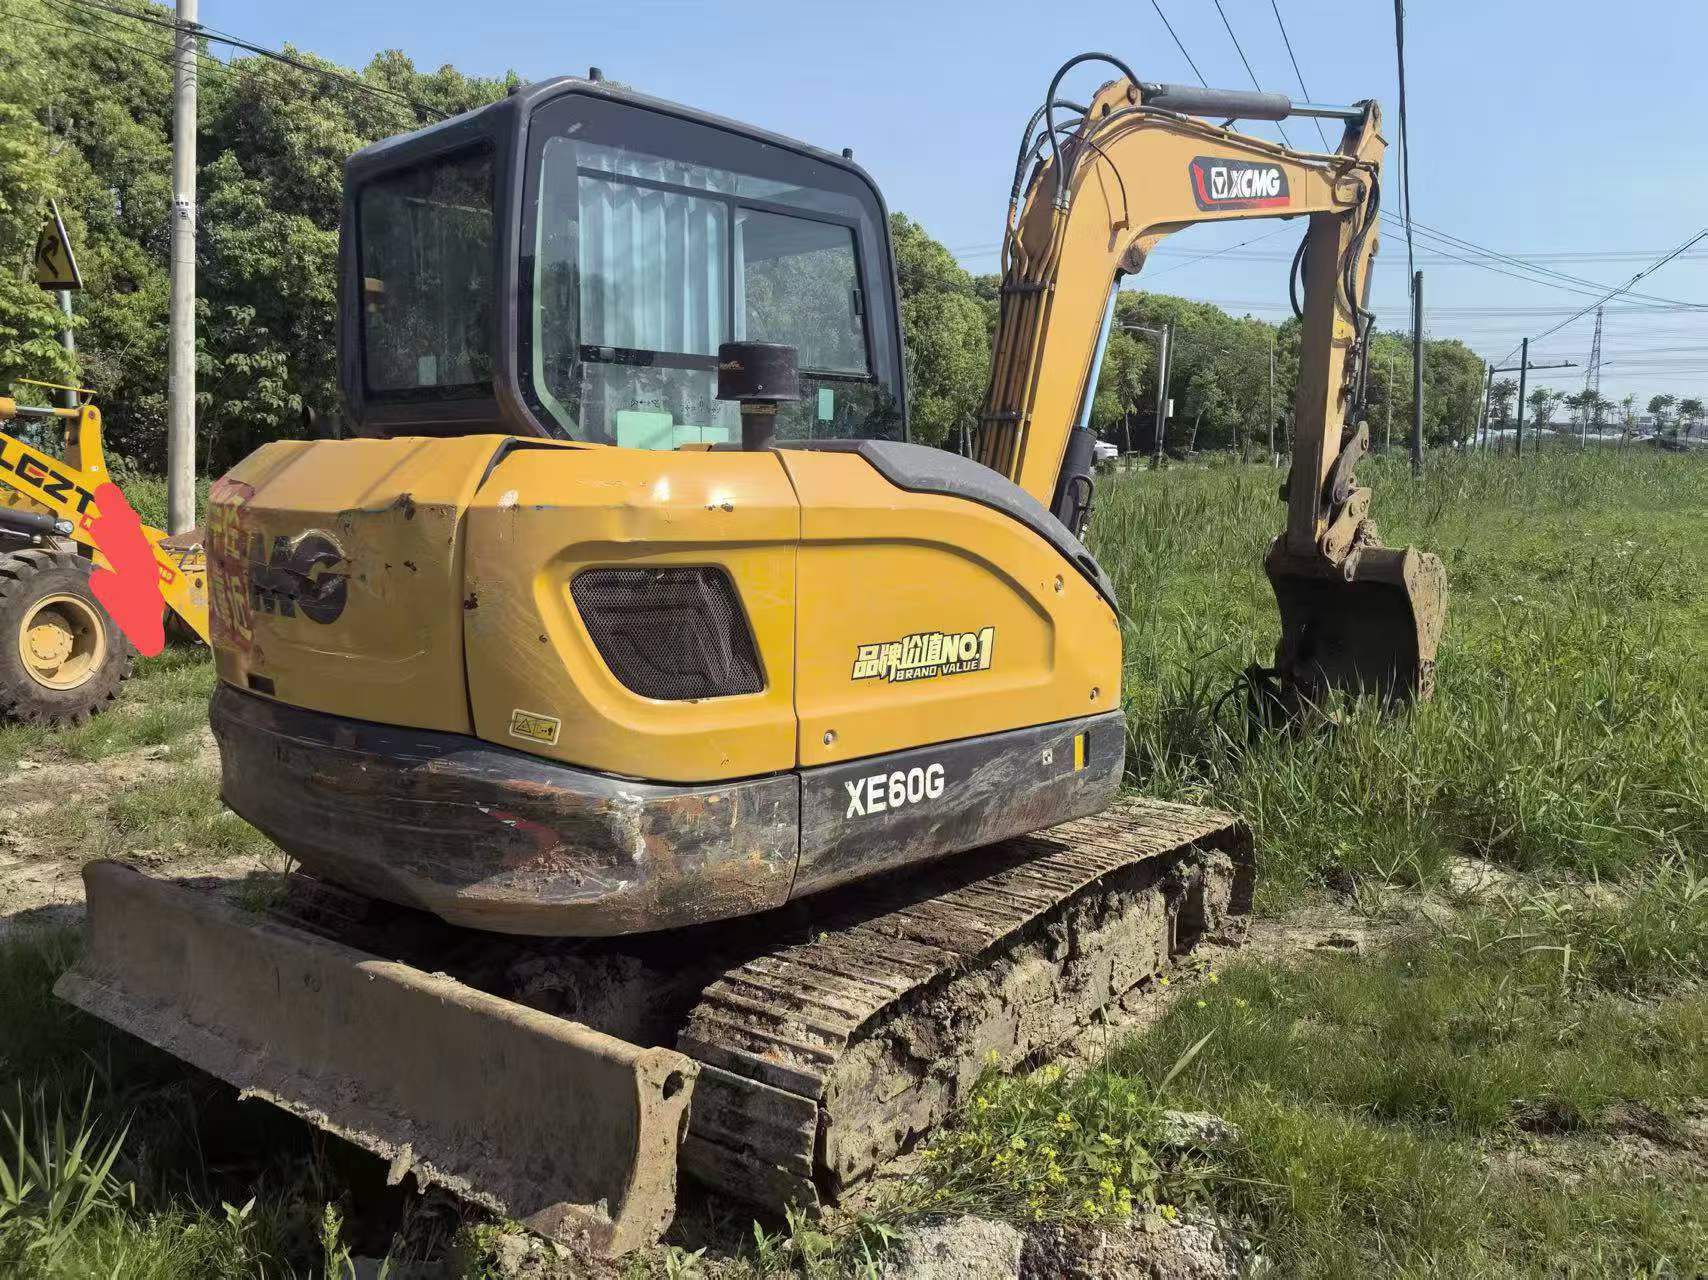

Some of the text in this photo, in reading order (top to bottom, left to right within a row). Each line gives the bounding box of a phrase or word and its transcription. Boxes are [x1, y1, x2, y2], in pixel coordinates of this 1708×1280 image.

[1229, 168, 1281, 198] XCMG
[896, 660, 978, 680] BRAND VALUE
[844, 763, 945, 819] XE60G
